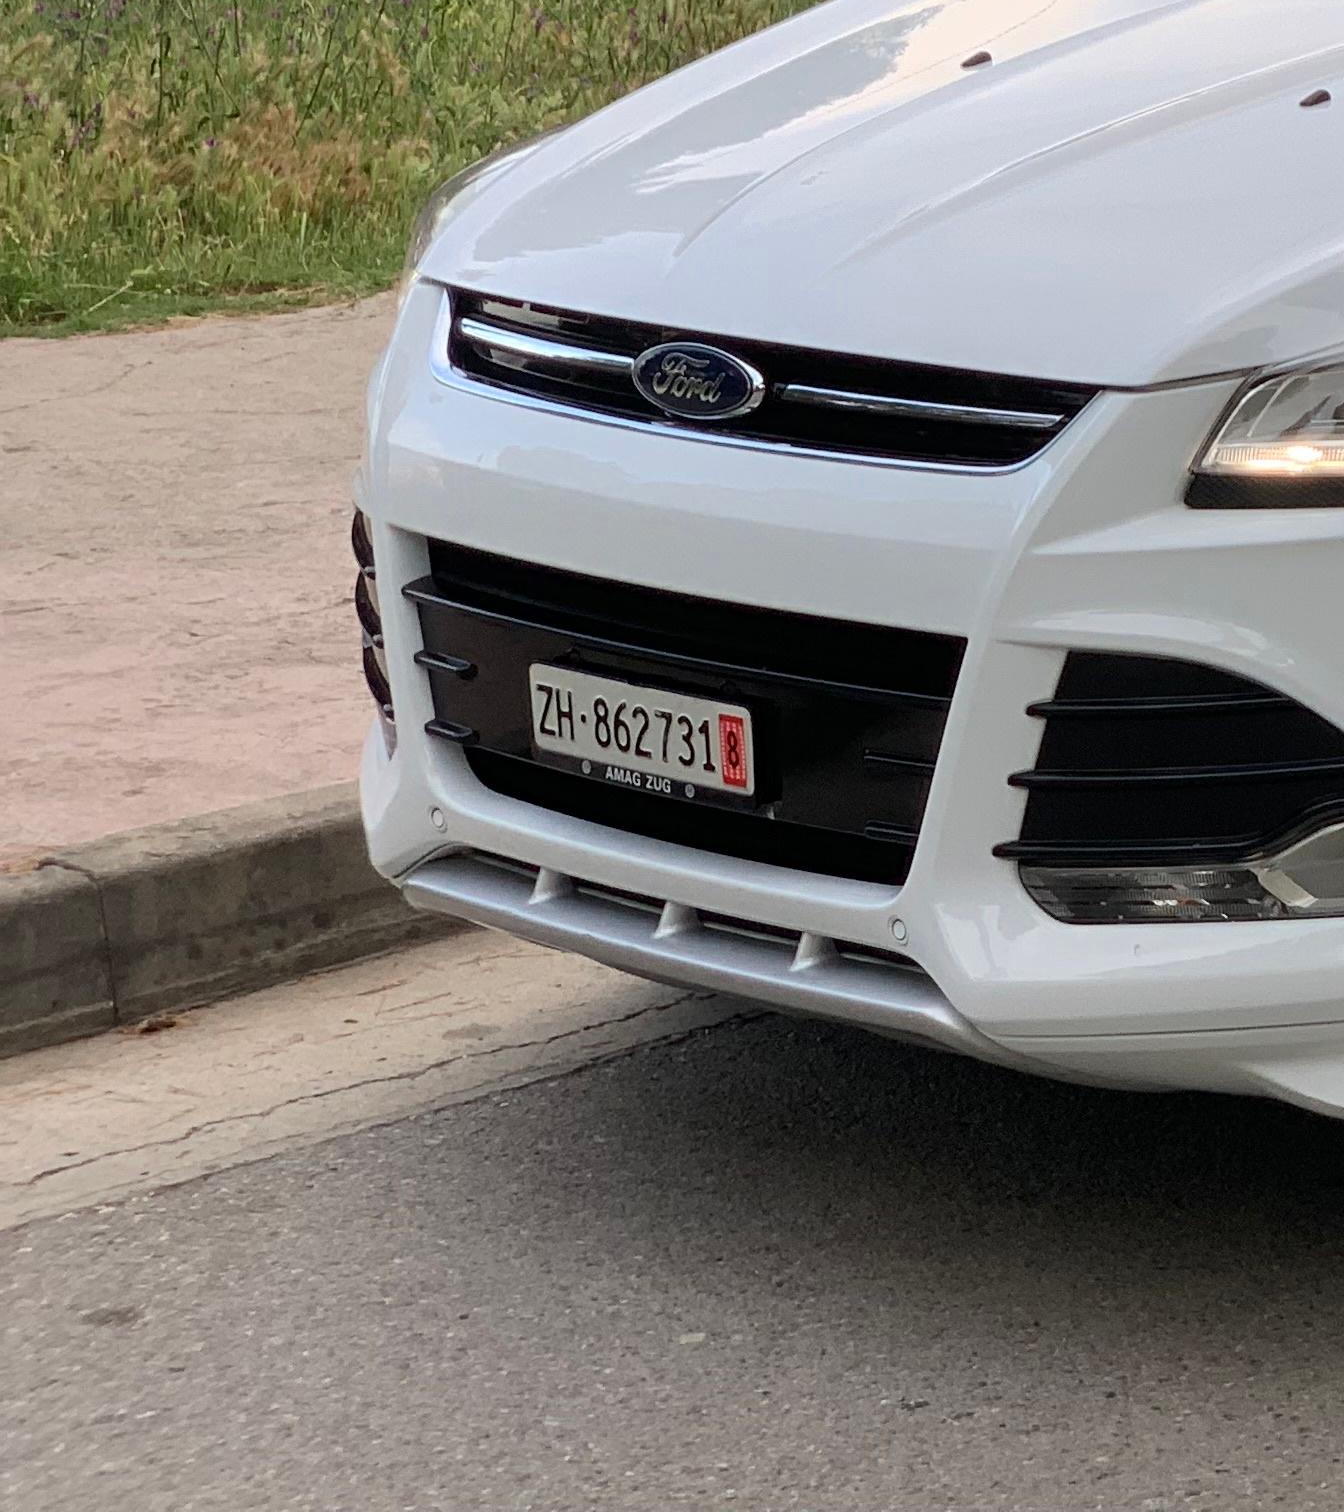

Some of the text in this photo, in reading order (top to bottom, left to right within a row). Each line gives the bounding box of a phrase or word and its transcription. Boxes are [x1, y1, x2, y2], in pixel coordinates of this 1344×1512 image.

[652, 352, 725, 403] Ford
[605, 765, 672, 794] AMAG ZUG
